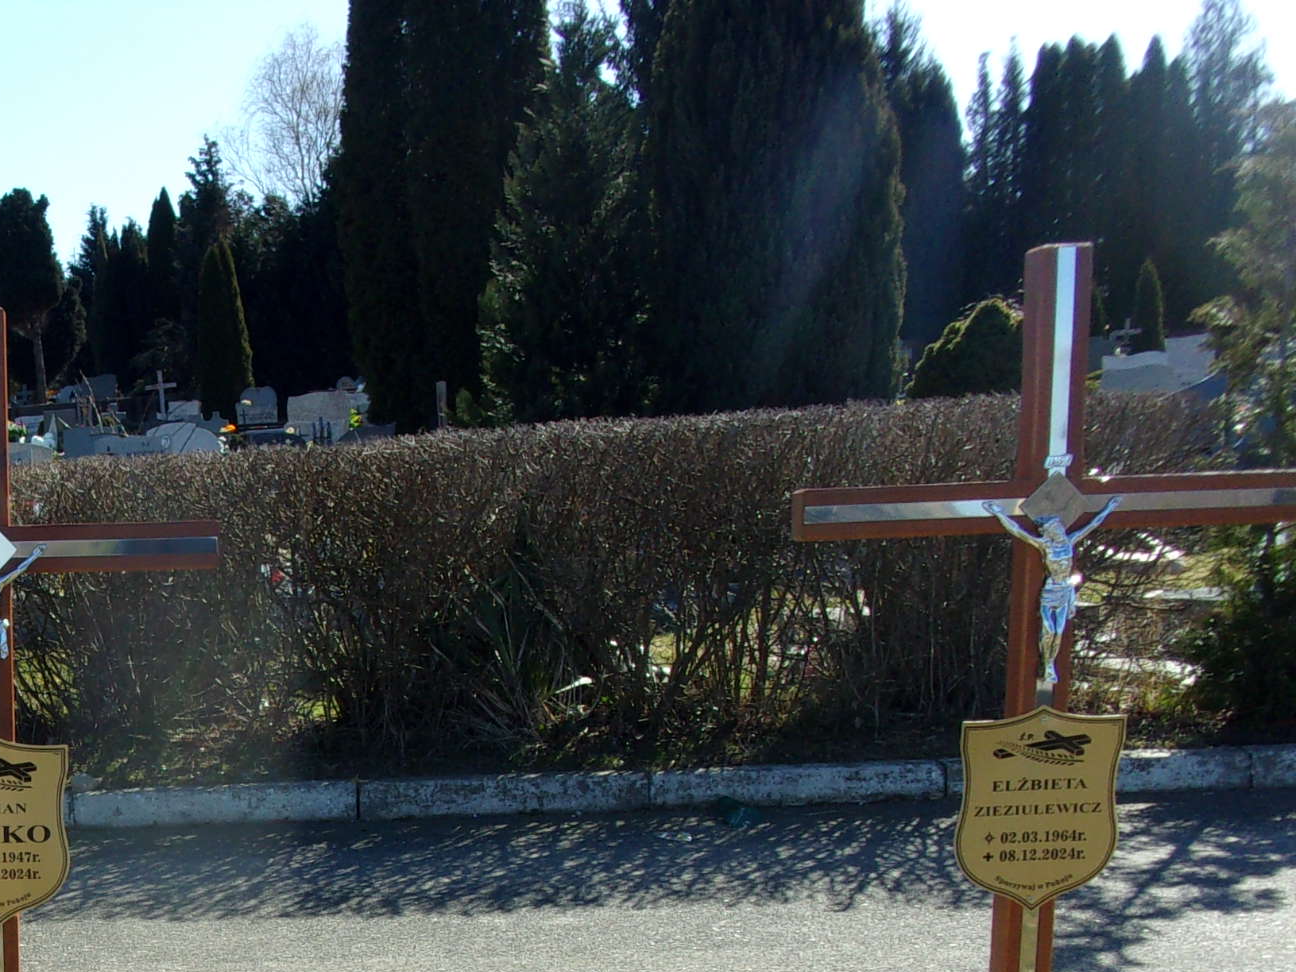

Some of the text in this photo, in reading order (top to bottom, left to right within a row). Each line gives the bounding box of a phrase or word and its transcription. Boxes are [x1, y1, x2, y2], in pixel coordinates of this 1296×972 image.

[992, 777, 1088, 792] ELŻBIETA
[974, 802, 1102, 817] ZIEZIULEWICZ
[1000, 830, 1087, 844] 02.03.1964r.
[999, 848, 1086, 862] 08.12.2024r.
